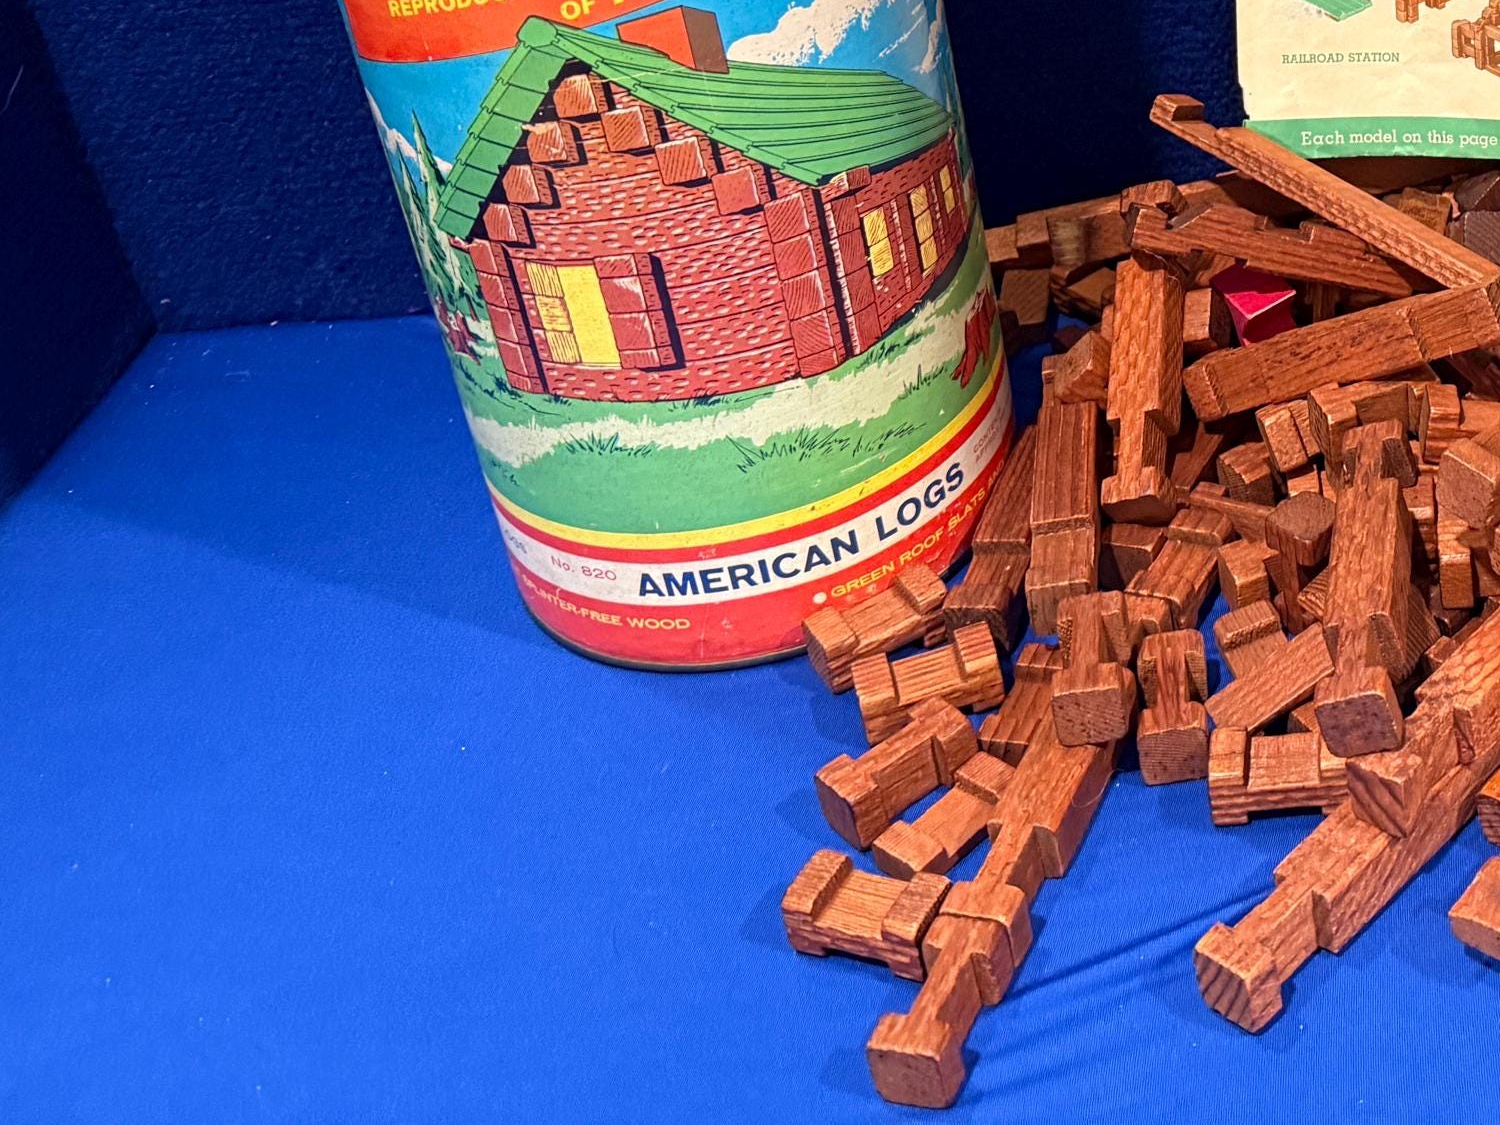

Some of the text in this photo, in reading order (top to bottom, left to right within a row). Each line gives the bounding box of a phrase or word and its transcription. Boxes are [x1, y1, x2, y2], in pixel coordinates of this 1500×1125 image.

[1281, 52, 1400, 64] RAILROAD STATION
[1300, 130, 1345, 146] Each
[1349, 129, 1398, 145] model
[1402, 132, 1422, 144] on
[1427, 130, 1454, 145] this
[1459, 133, 1498, 149] page
[550, 461, 965, 597] No. 820 AMERICAN LOGS
[830, 561, 896, 599] GREEN
[899, 527, 945, 565] ROOF
[946, 488, 986, 533] SLATS
[625, 616, 691, 630] WOOD
